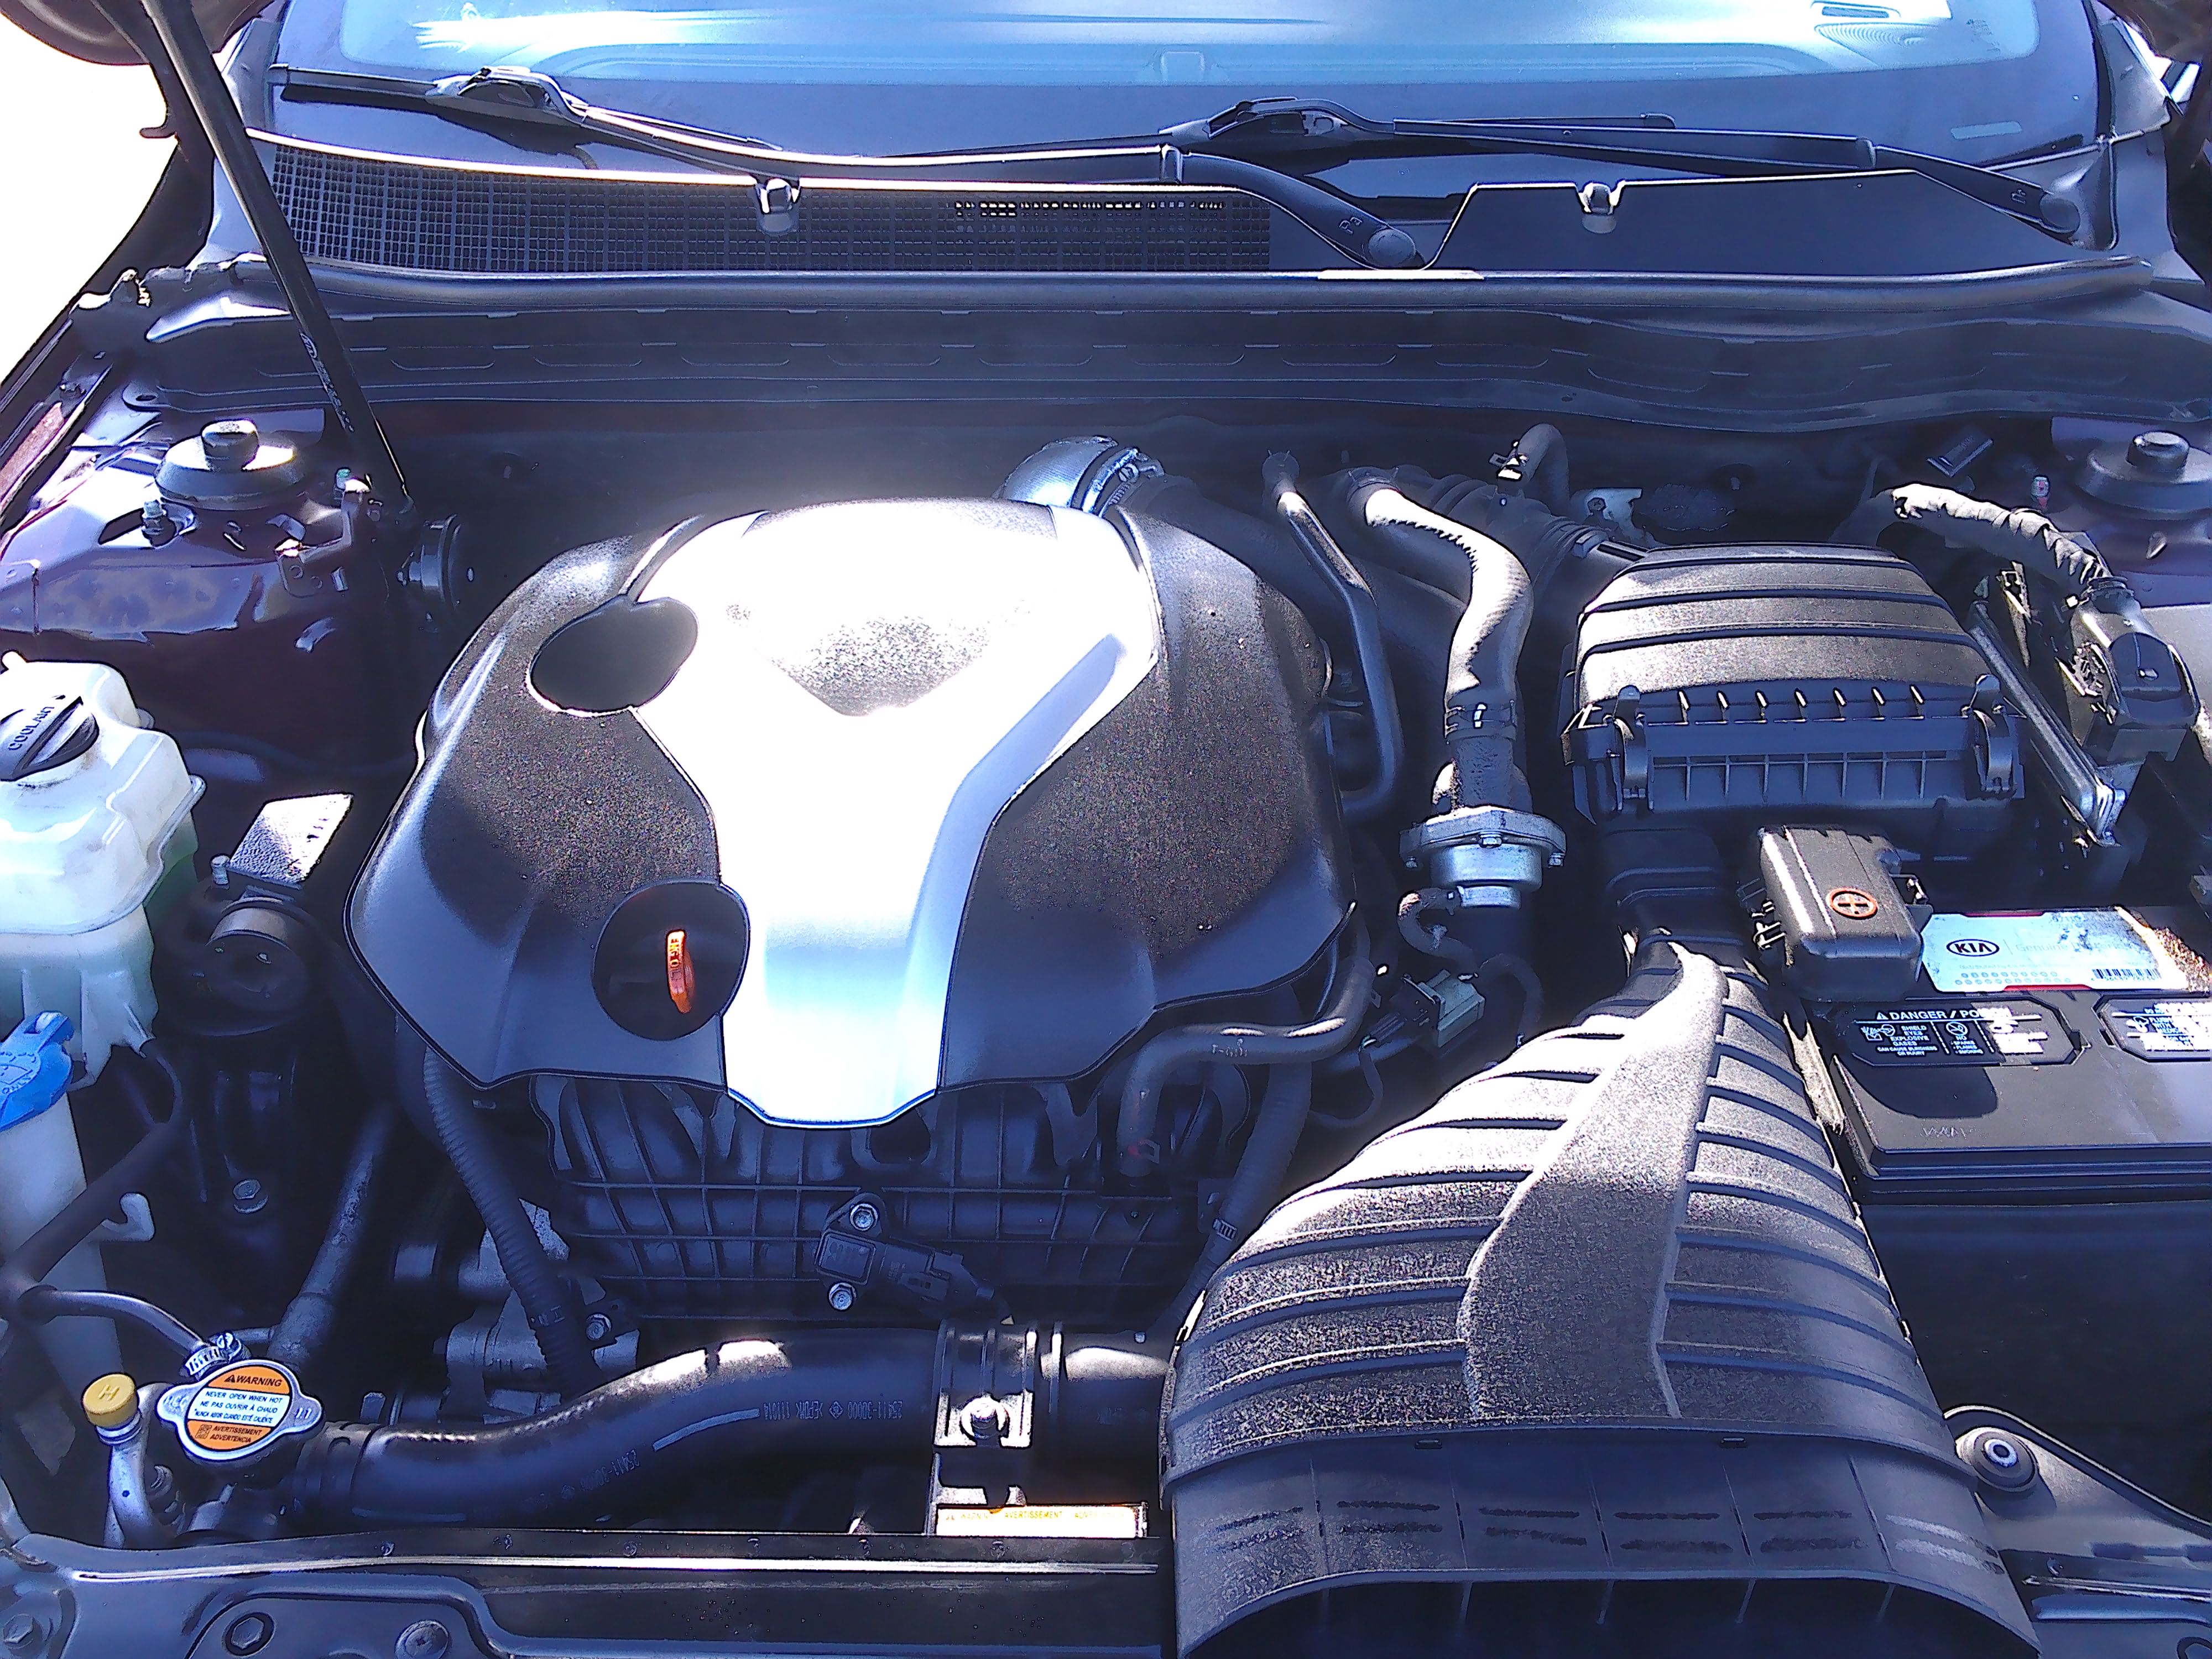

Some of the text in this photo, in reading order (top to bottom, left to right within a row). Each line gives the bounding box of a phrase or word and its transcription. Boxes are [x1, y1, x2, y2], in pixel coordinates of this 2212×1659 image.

[1955, 943, 1991, 954] KIA
[1888, 1011, 1947, 1020] DANGER
[237, 1375, 283, 1387] WARNING
[212, 1425, 262, 1436] AVERTISSEMENT
[210, 1433, 251, 1443] ADVERTENCIA
[1004, 1511, 1062, 1519] AVERTISSEMENT
